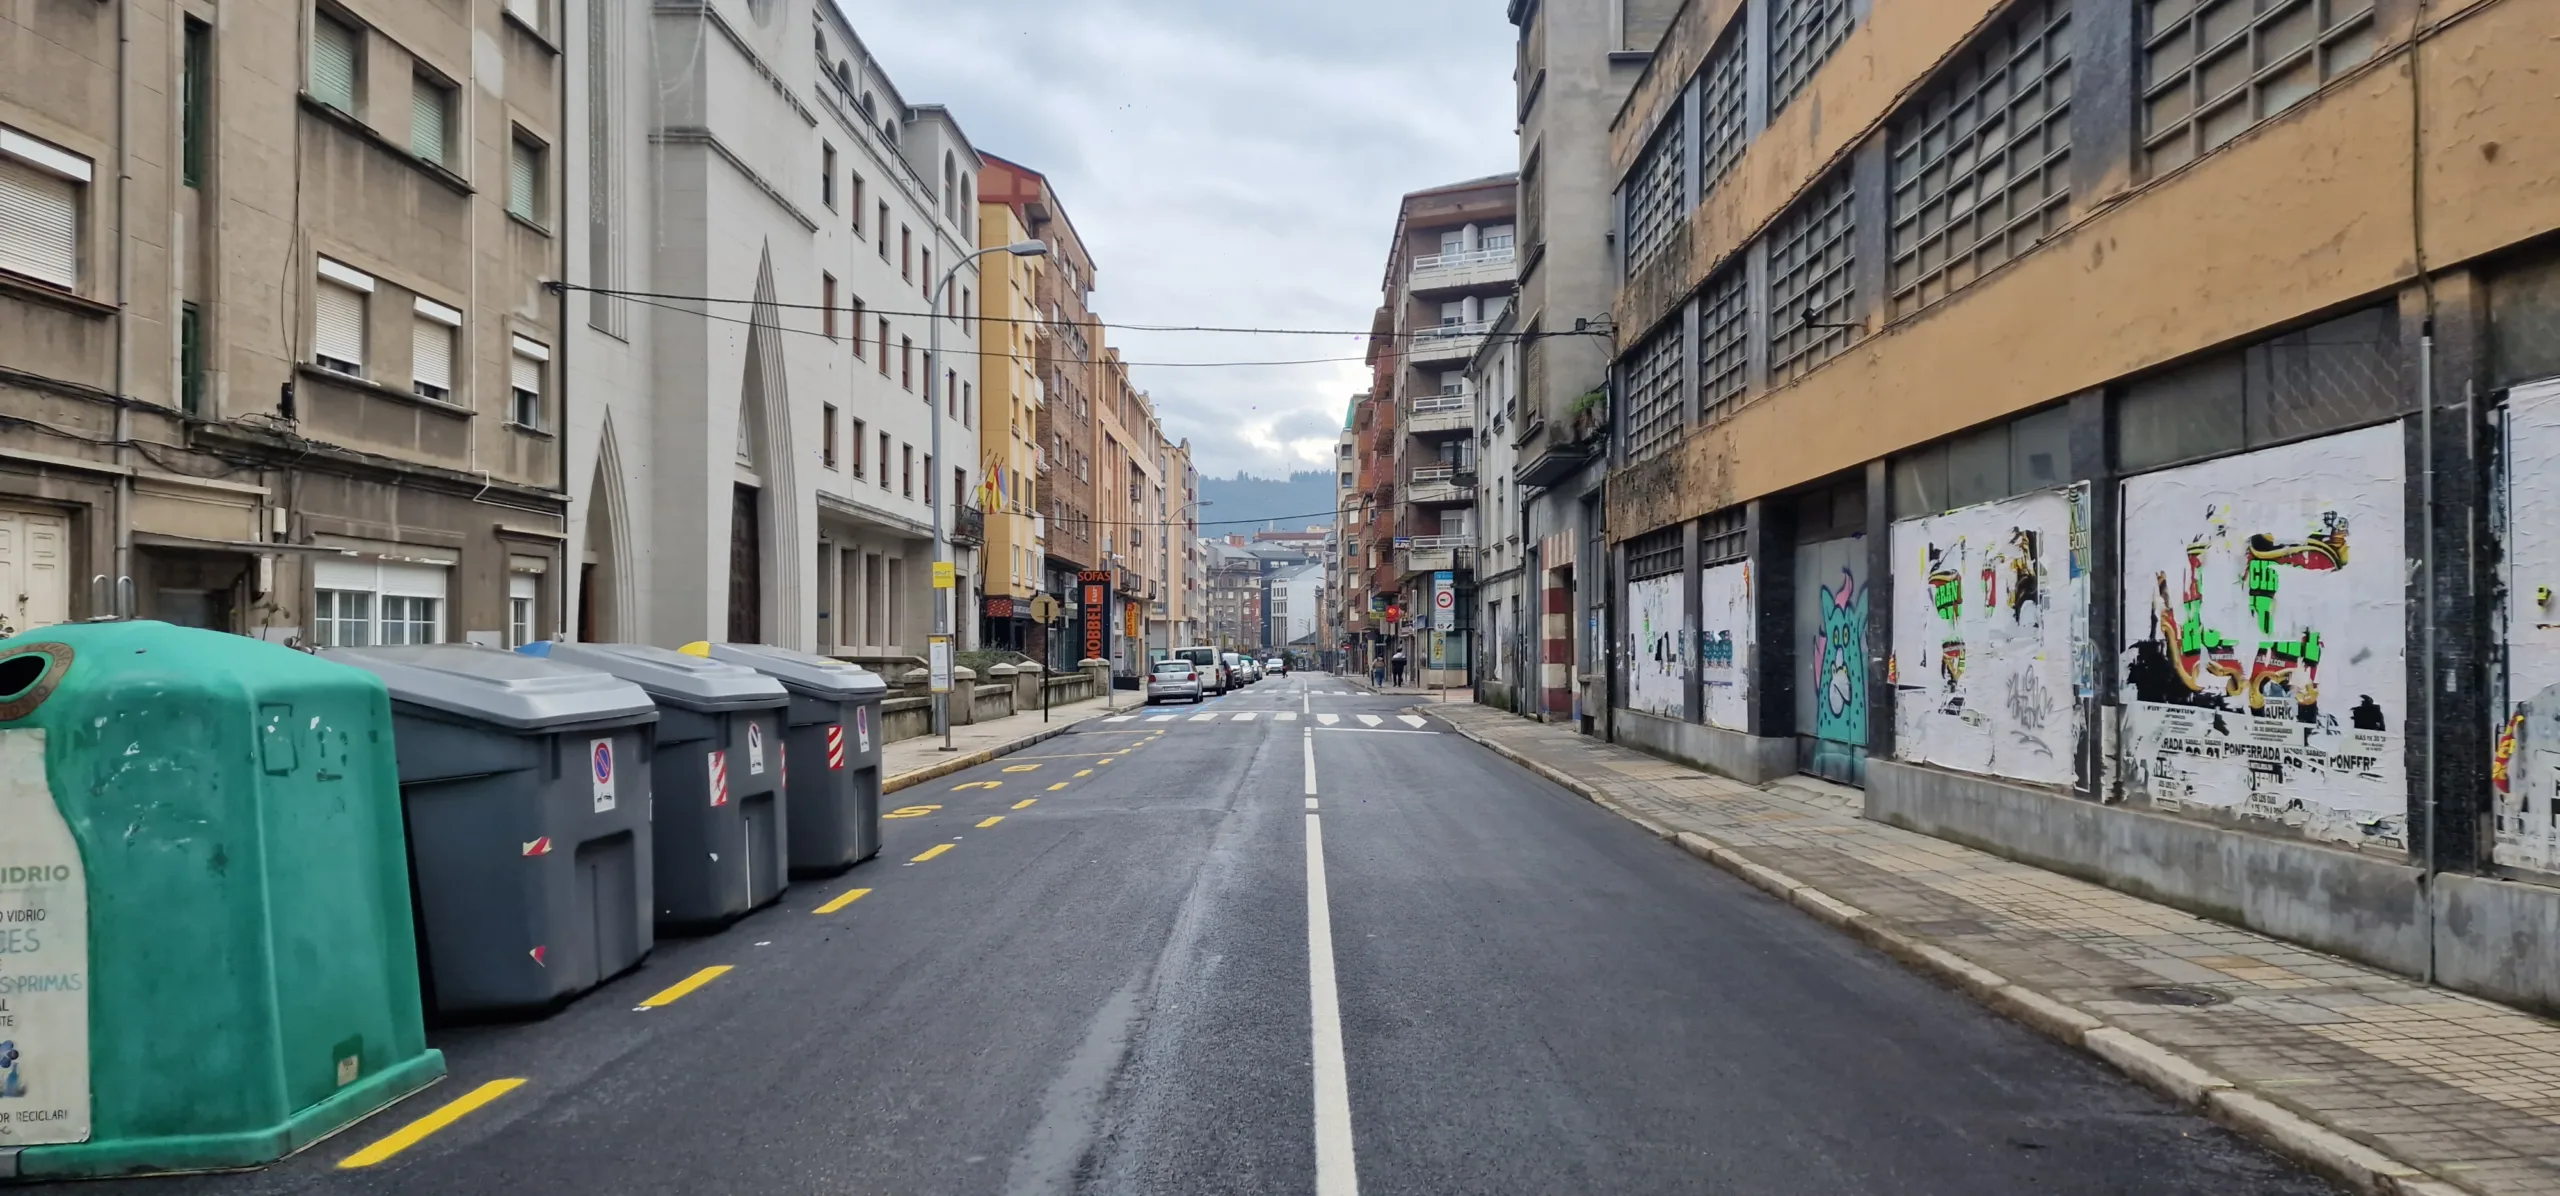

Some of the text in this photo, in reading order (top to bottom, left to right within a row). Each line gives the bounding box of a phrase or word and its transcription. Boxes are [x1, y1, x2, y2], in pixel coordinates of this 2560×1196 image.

[1078, 571, 1111, 582] SOFAS
[1935, 580, 1959, 606] GRAN
[2161, 737, 2184, 752] RADA
[1, 865, 70, 884] IDRIO
[7, 908, 46, 923] VIDRIO
[18, 973, 83, 994] PRIMAS
